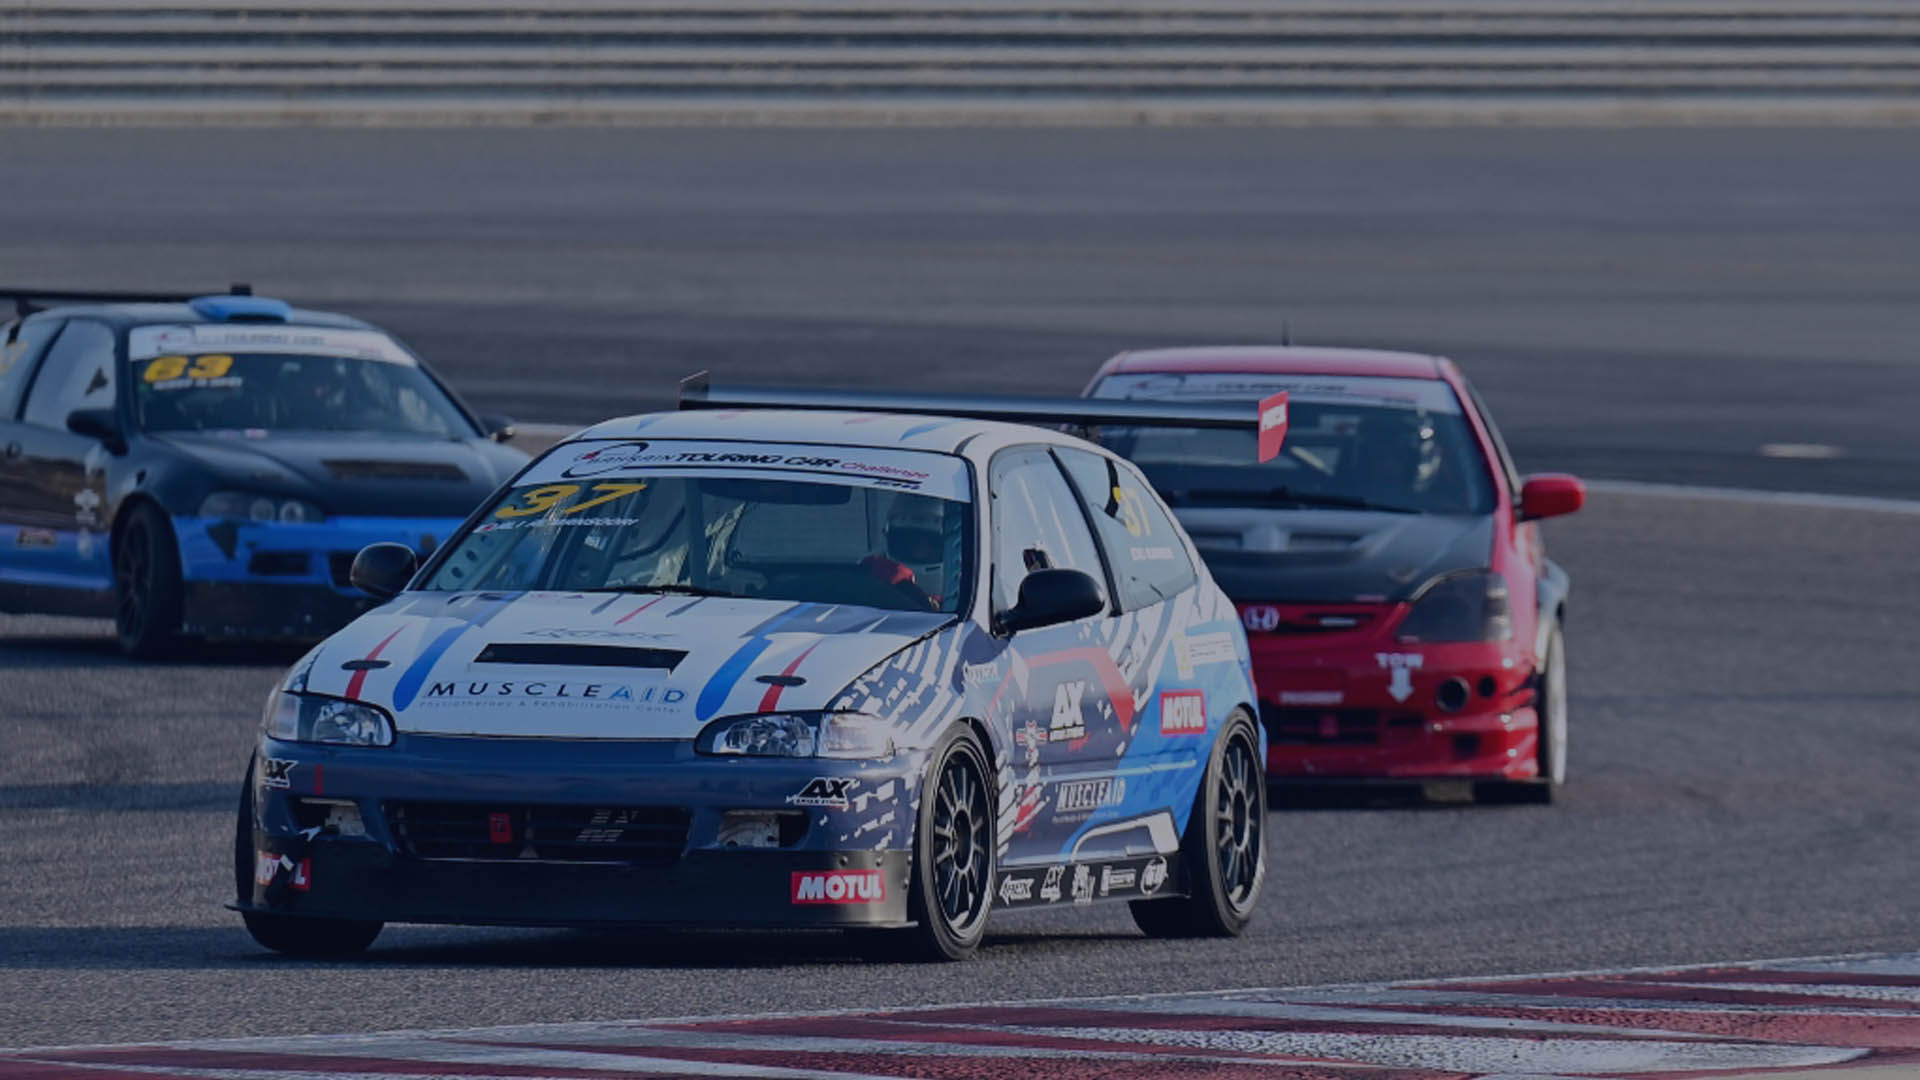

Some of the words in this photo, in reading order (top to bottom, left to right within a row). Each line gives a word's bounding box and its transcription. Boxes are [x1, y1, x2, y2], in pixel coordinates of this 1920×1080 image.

[675, 453, 783, 463] TOURING
[784, 456, 841, 467] CAR
[495, 484, 647, 519] 37
[427, 681, 687, 704] MUSCLEAID
[1162, 694, 1204, 729] MOTUL
[799, 778, 854, 799] AX
[796, 873, 883, 901] MOTUL
